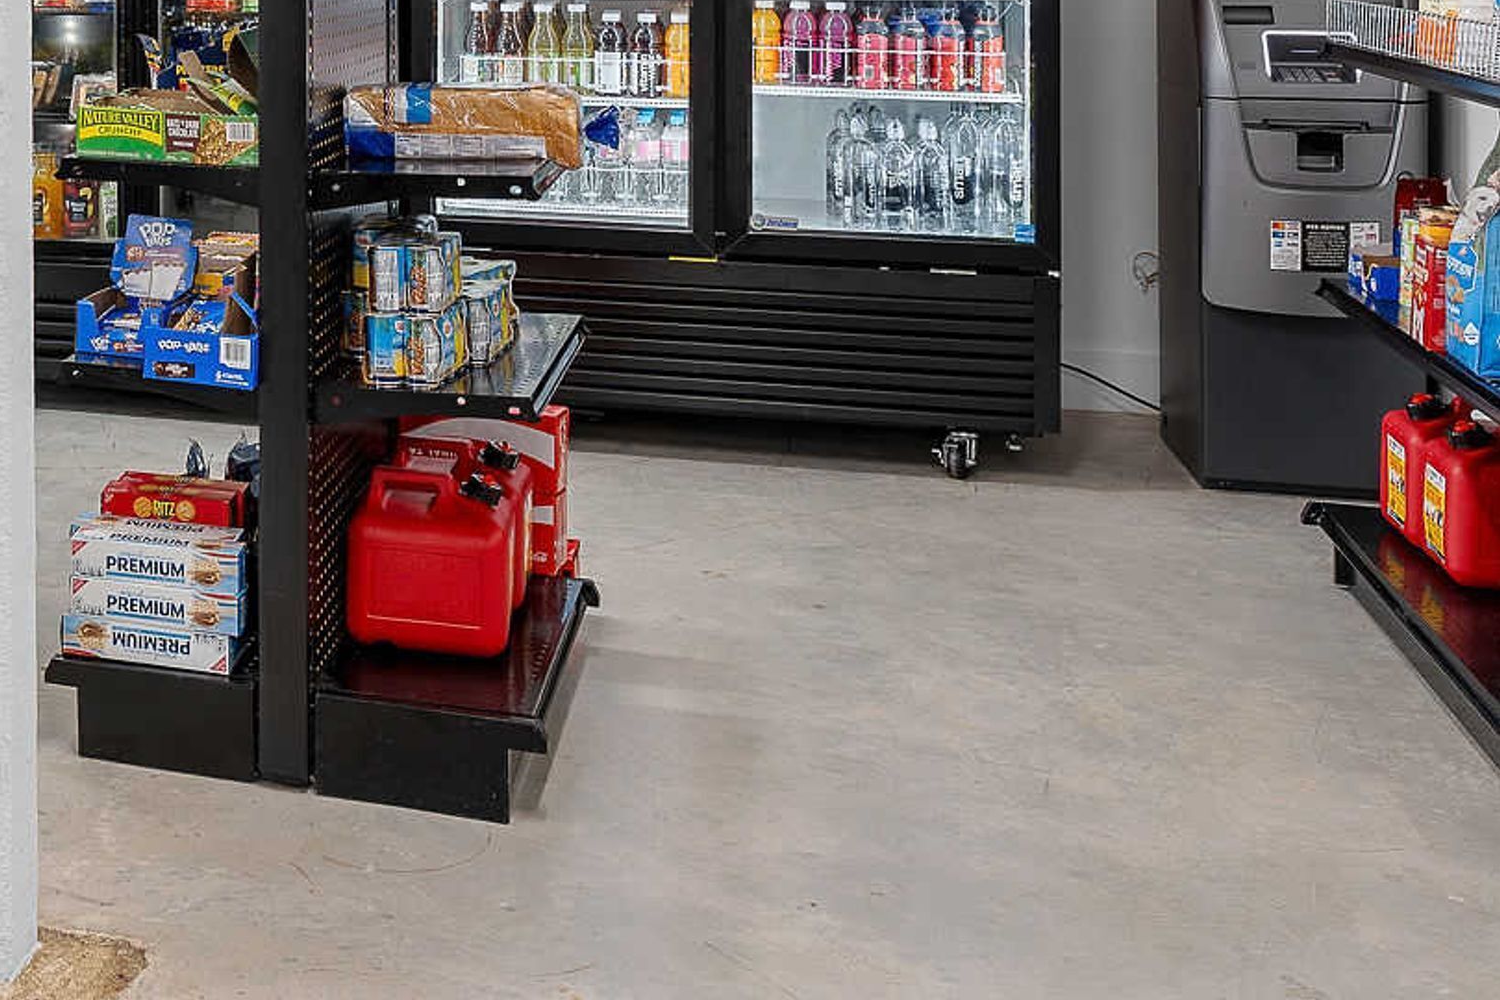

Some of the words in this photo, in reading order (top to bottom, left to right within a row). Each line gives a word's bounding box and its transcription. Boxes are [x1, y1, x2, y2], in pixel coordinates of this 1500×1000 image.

[82, 107, 121, 127] NATURE
[121, 111, 161, 133] VALLEY
[153, 503, 176, 518] RITZ
[106, 555, 186, 578] PREMIUM
[106, 595, 186, 619] PREMIUM
[111, 631, 192, 656] PREMIUM
